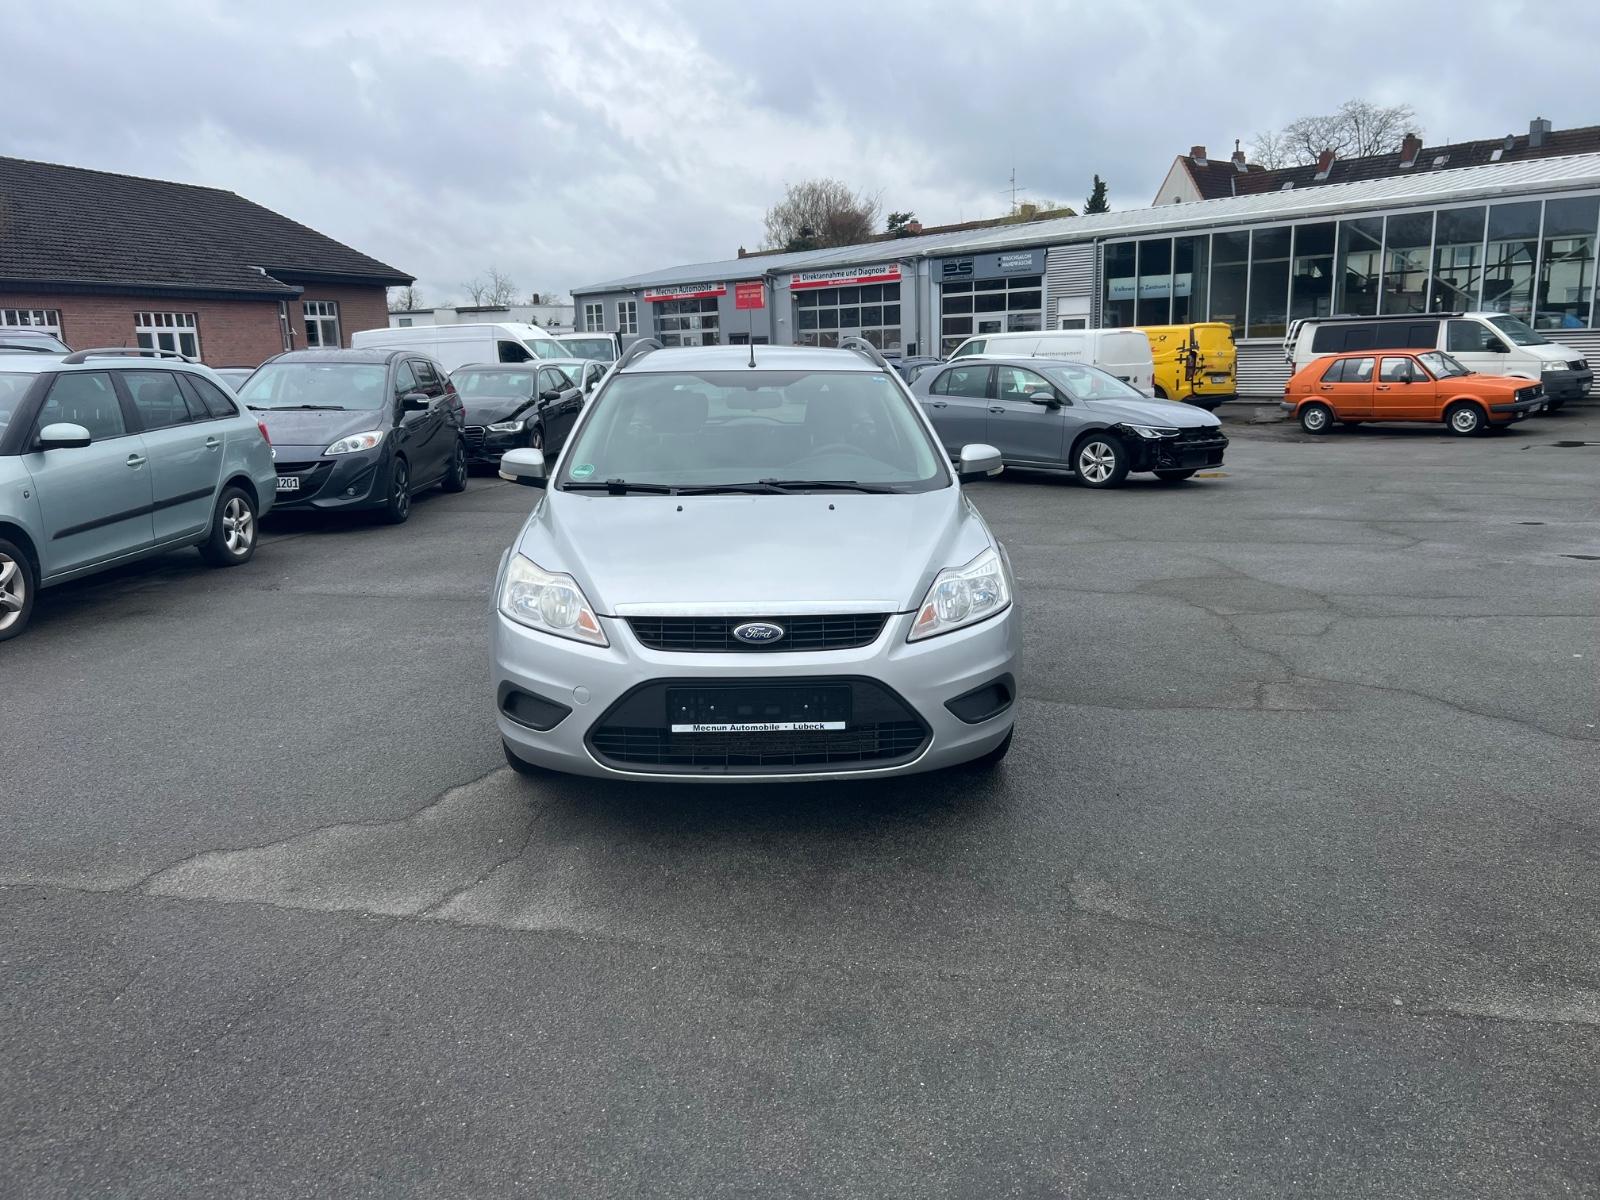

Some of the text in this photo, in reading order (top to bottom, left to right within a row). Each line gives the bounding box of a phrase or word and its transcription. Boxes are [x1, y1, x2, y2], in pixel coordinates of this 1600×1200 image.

[802, 271, 844, 281] Direktannahme
[845, 269, 857, 277] und
[858, 266, 886, 276] Diagnose
[679, 282, 712, 293] Automobile
[745, 627, 772, 639] Ford
[693, 724, 727, 732] Mecnun
[730, 723, 780, 731] Automobile
